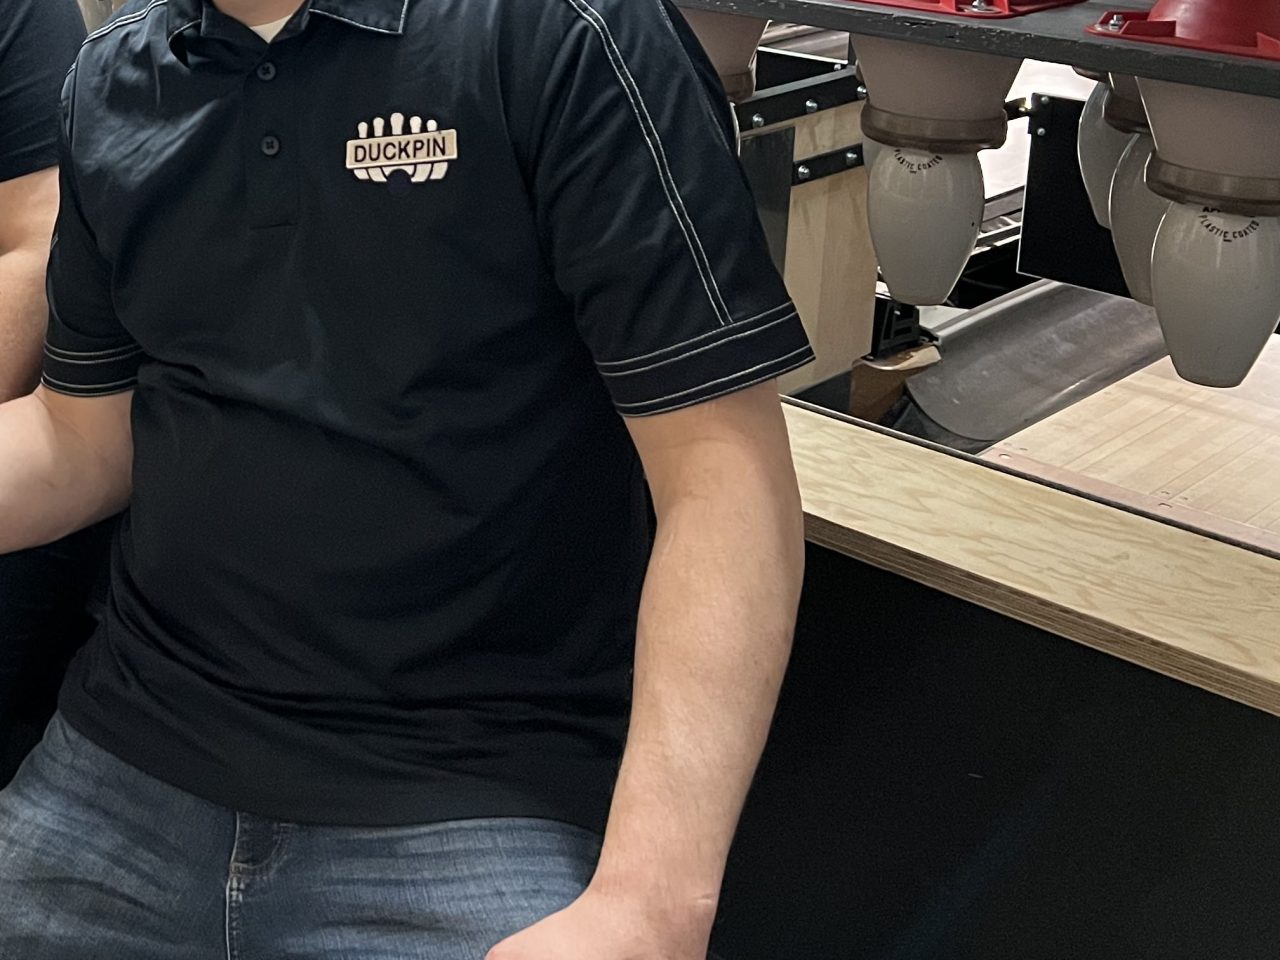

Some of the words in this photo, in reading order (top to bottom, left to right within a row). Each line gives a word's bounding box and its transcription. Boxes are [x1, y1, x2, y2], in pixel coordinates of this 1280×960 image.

[354, 136, 446, 163] DUCKPIN
[1199, 214, 1228, 238] PLASTIC
[1232, 220, 1260, 239] COATED
